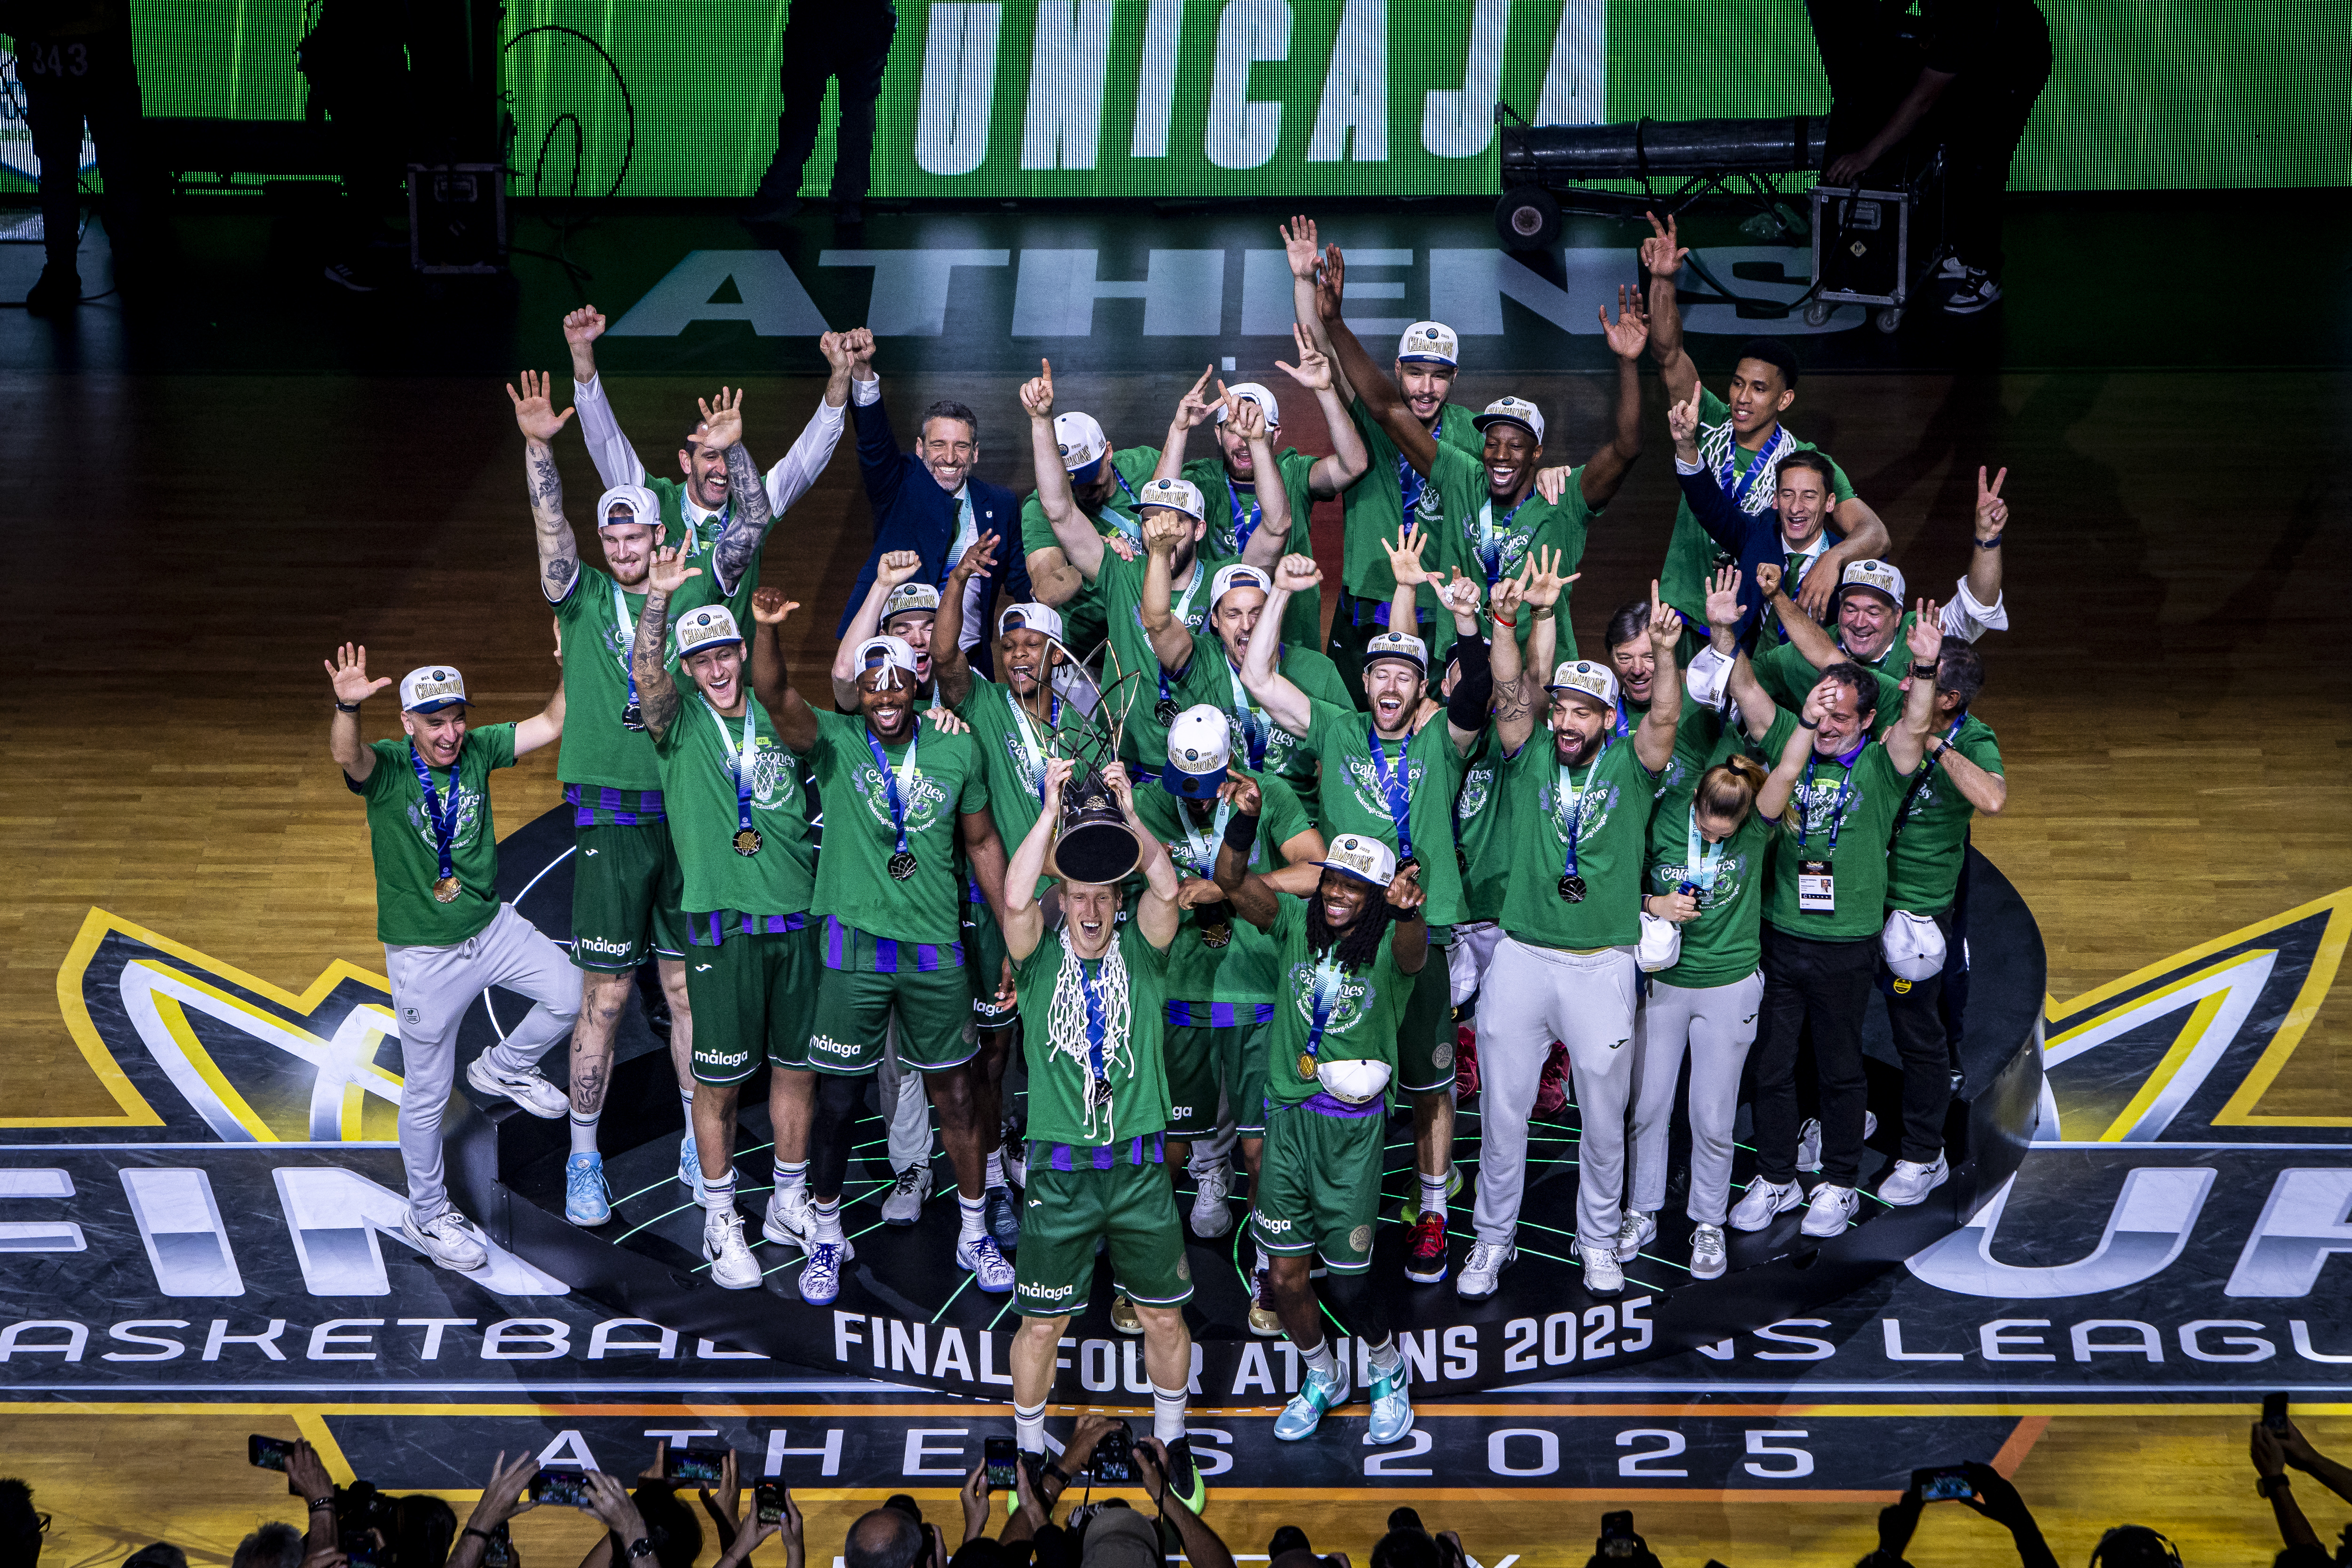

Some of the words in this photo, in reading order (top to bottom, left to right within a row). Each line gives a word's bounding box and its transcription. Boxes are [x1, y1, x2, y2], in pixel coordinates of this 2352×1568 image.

[31, 41, 89, 77] 343
[914, 0, 1607, 176] UNICAJA
[603, 248, 1867, 337] ATHENS
[1407, 335, 1454, 358] CHAMPIONS
[1064, 444, 1091, 467] PIONS
[1144, 488, 1189, 508] CHAMPIONS
[1846, 569, 1894, 591] CHAMPIONS
[888, 594, 936, 613] CHAMPIONS
[682, 618, 732, 646] CHAMPIONS
[1557, 669, 1606, 695] CHAMPIONS
[1171, 750, 1218, 772] CHAMPIONS
[866, 769, 946, 802] Caones
[1699, 899, 1727, 909] hampions
[974, 998, 1003, 1016] laga
[1296, 998, 1314, 1026] Basketba
[834, 1310, 1011, 1384] FINAL
[1505, 1296, 1653, 1373] 2025
[537, 1428, 1233, 1477] ATHES
[1364, 1428, 1815, 1478] 2025
